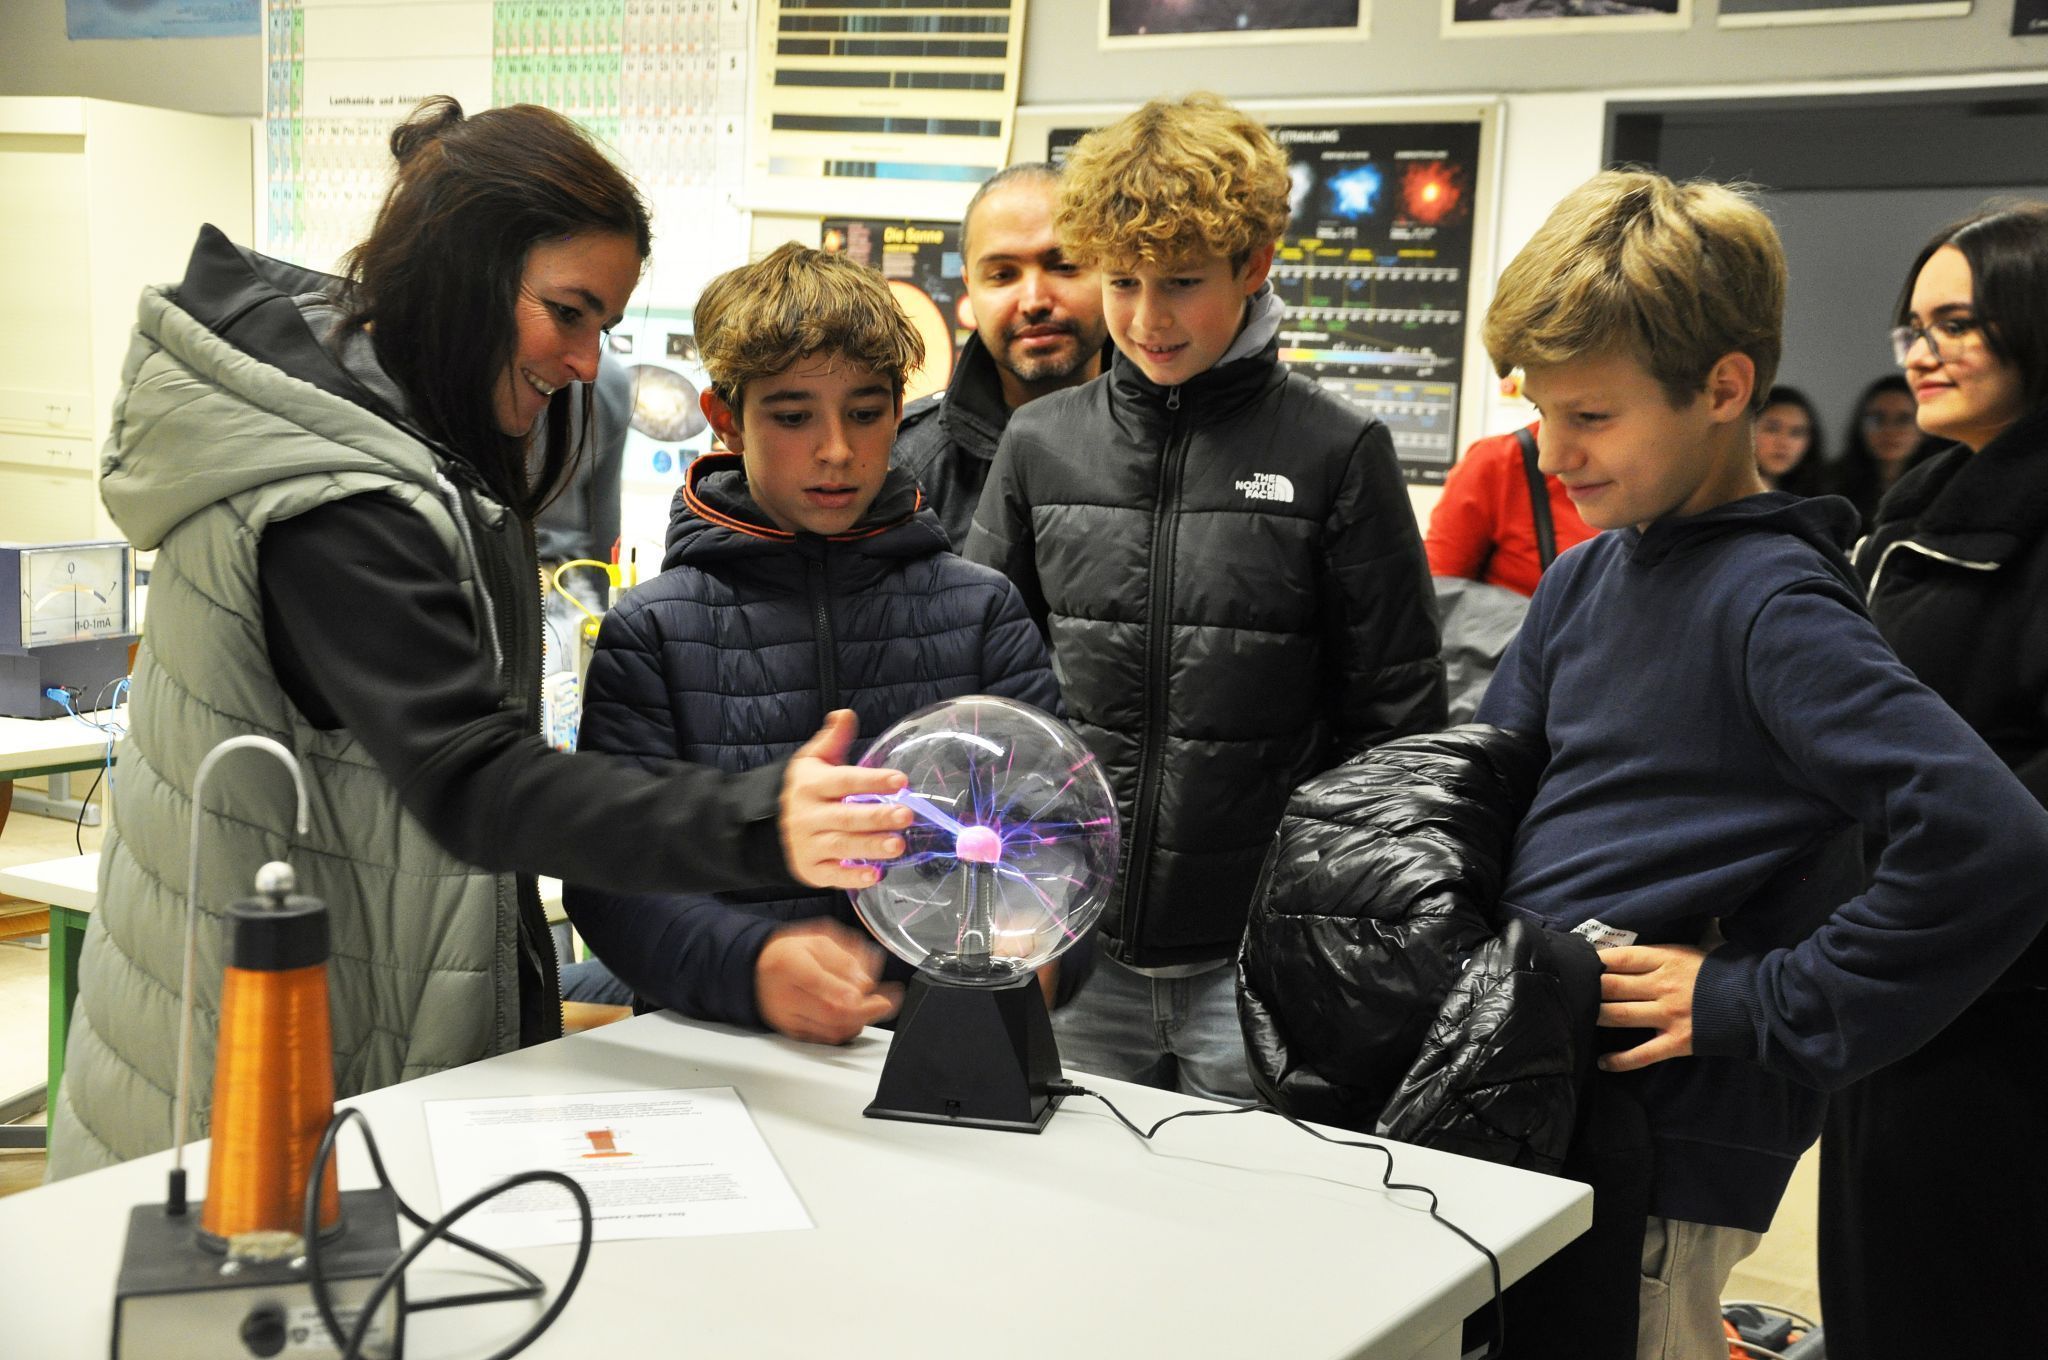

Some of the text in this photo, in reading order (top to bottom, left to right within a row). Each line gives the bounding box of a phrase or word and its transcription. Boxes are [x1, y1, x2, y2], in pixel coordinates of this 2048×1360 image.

[379, 95, 394, 105] und
[884, 226, 945, 245] Die Sonne
[1253, 472, 1276, 483] THE
[1235, 480, 1275, 491] NORTH
[1245, 490, 1274, 500] FACE
[67, 561, 75, 575] 0
